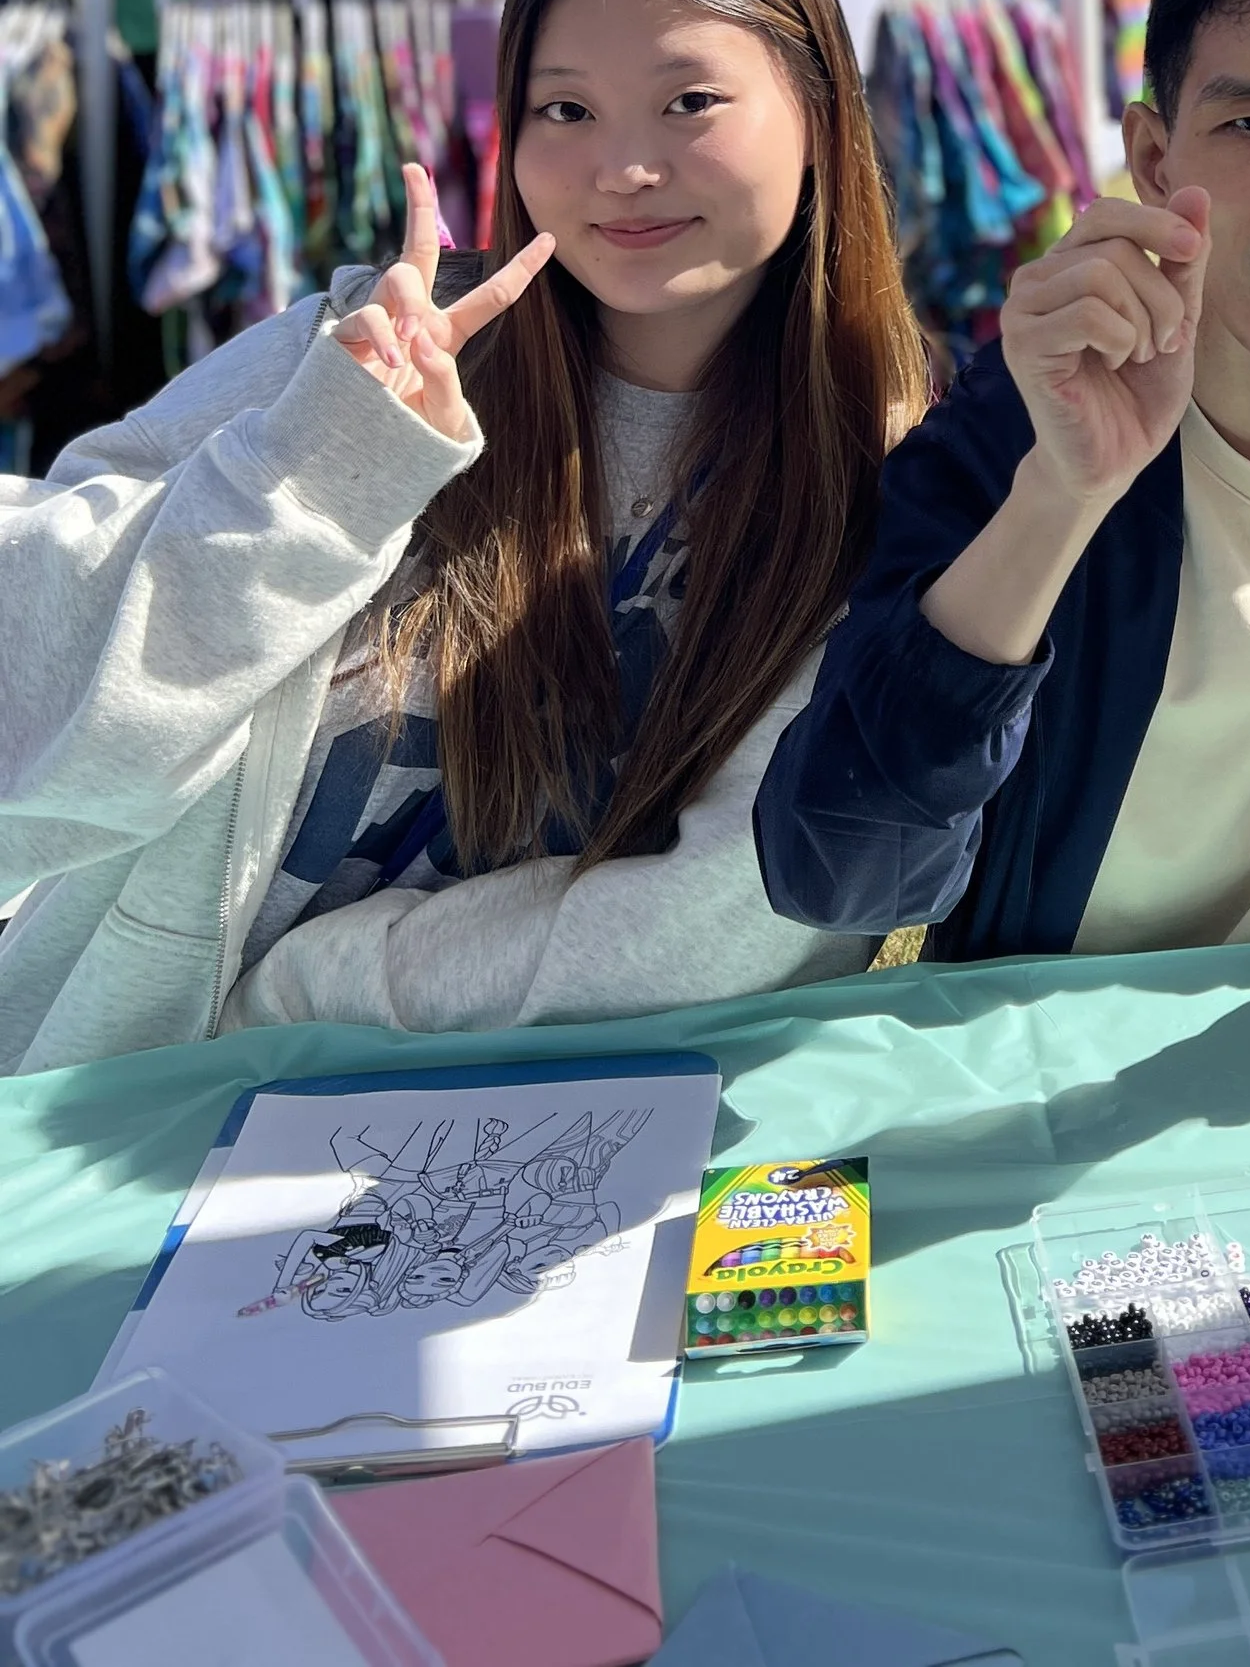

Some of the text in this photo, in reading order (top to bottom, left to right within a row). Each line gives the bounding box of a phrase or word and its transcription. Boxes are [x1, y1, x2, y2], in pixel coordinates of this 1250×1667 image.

[769, 1168, 801, 1183] 24
[734, 1186, 833, 1206] CRAYONS
[718, 1196, 849, 1220] WASHABLE
[729, 1210, 834, 1229] ULTRA-CLEAN
[716, 1260, 844, 1281] Crayola
[507, 1379, 592, 1393] EDU BUD
